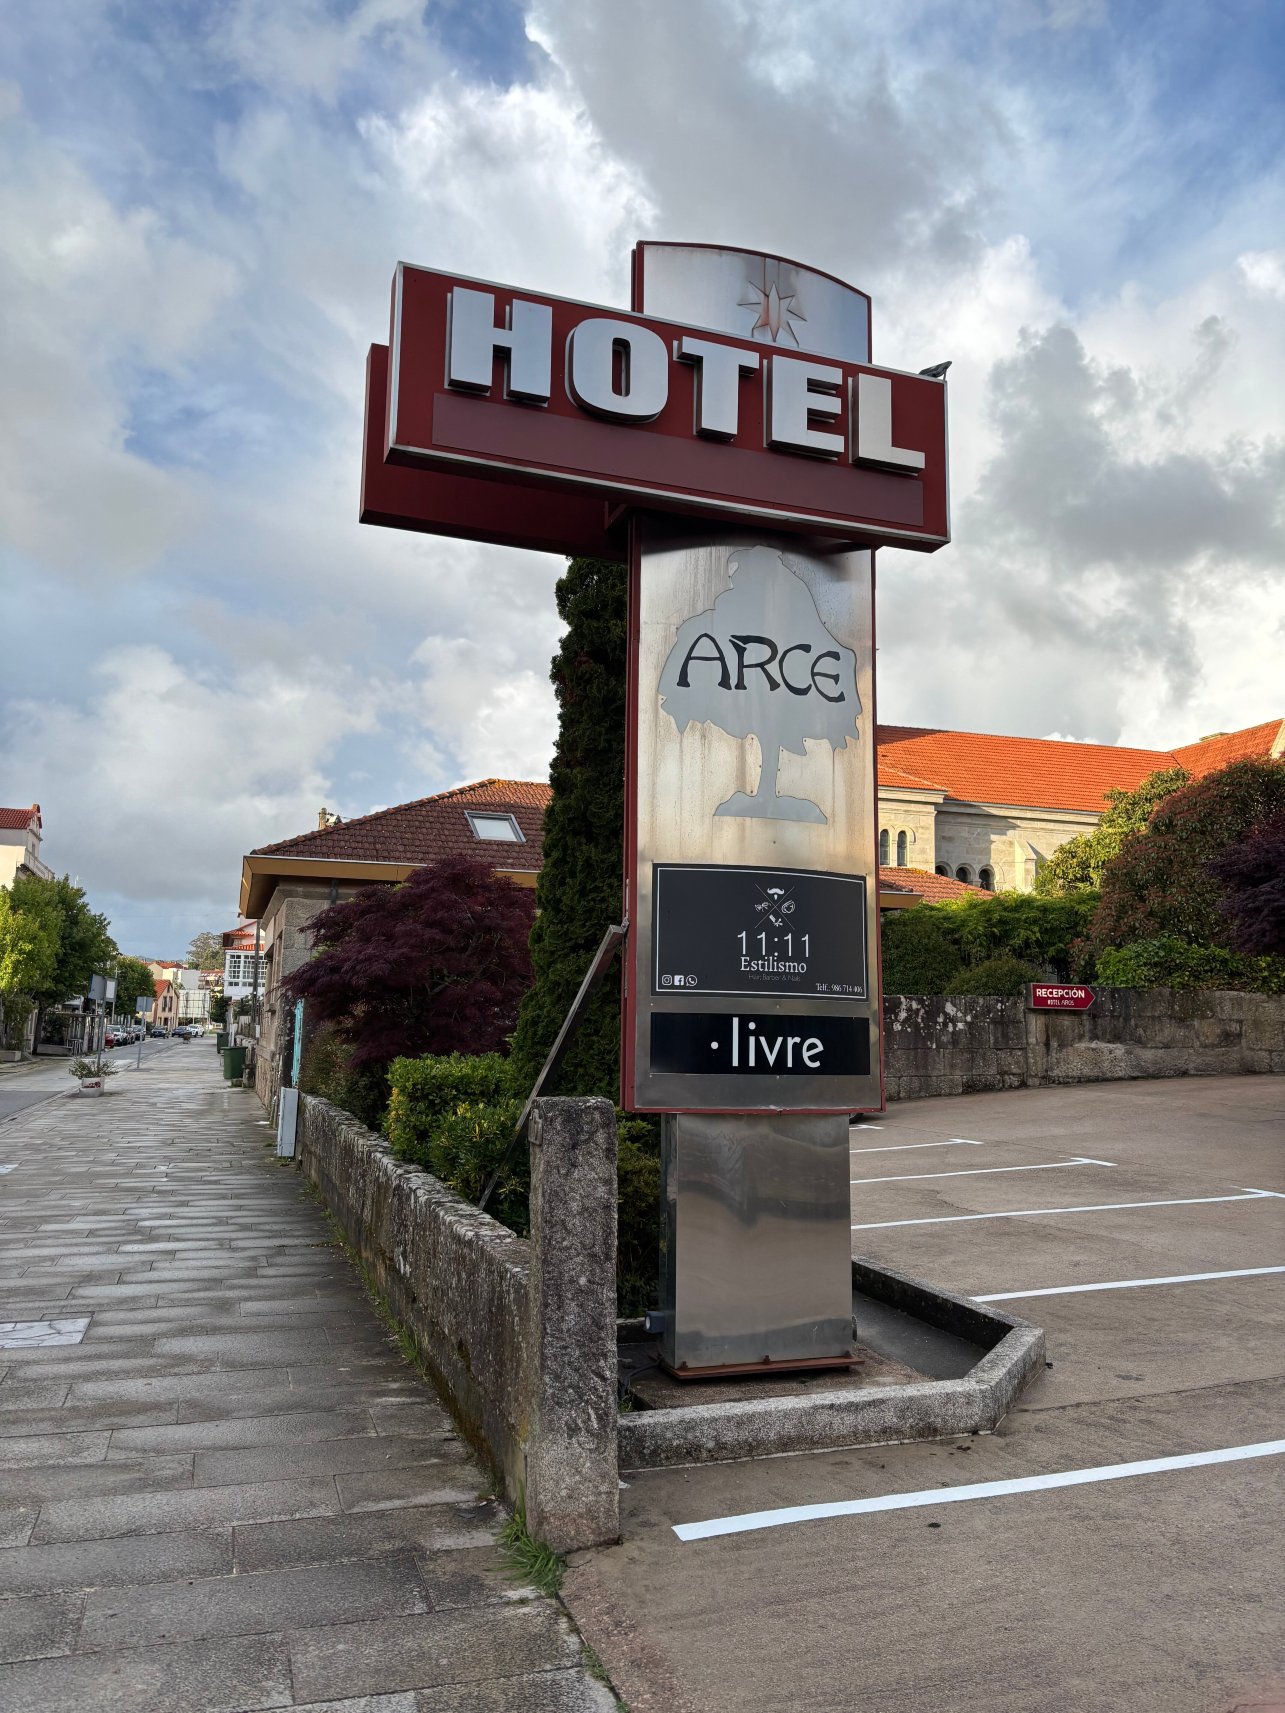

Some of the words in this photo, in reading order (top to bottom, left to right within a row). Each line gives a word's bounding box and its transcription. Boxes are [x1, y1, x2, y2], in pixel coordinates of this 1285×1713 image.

[444, 286, 925, 476] HOTEL
[676, 632, 846, 703] ARCE
[737, 930, 809, 957] 11:11
[740, 956, 807, 973] Estilismo
[1036, 987, 1085, 998] RECEPCIÓN
[732, 1017, 824, 1068] livre
